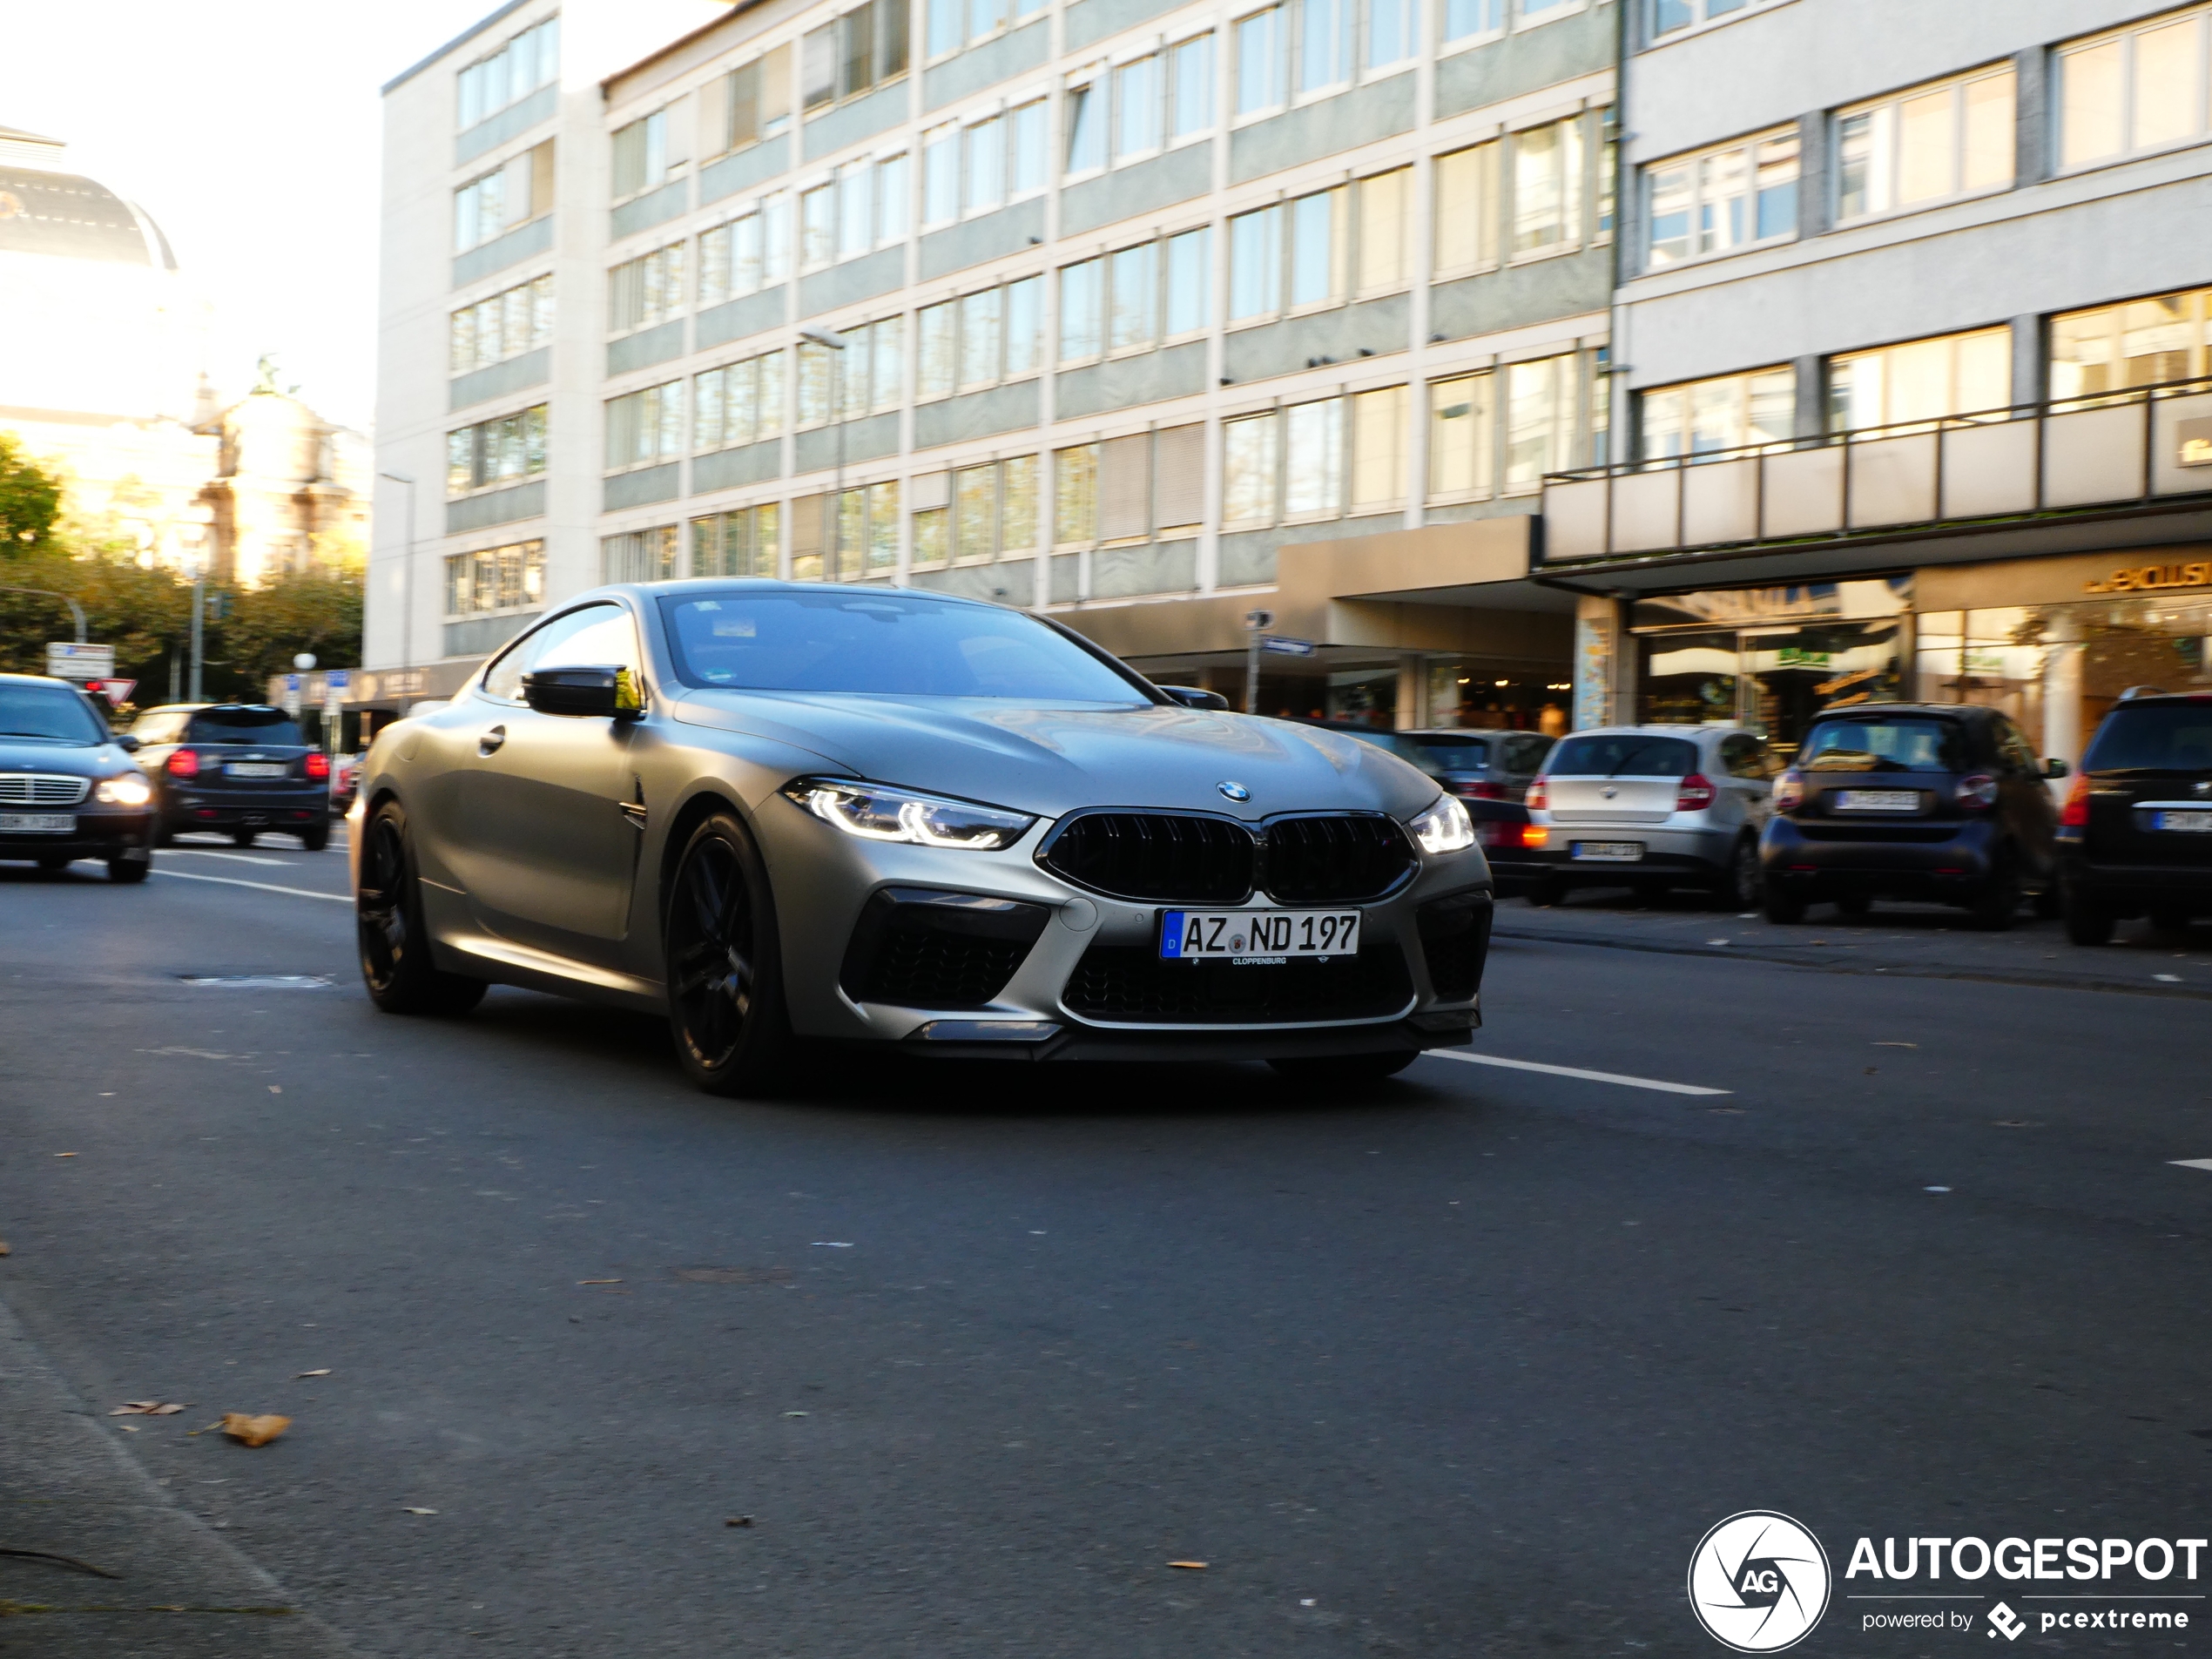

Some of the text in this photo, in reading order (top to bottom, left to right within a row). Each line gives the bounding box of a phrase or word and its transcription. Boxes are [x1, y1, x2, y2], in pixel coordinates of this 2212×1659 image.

[1168, 939, 1176, 949] D
[1184, 915, 1357, 952] AZ ND 197
